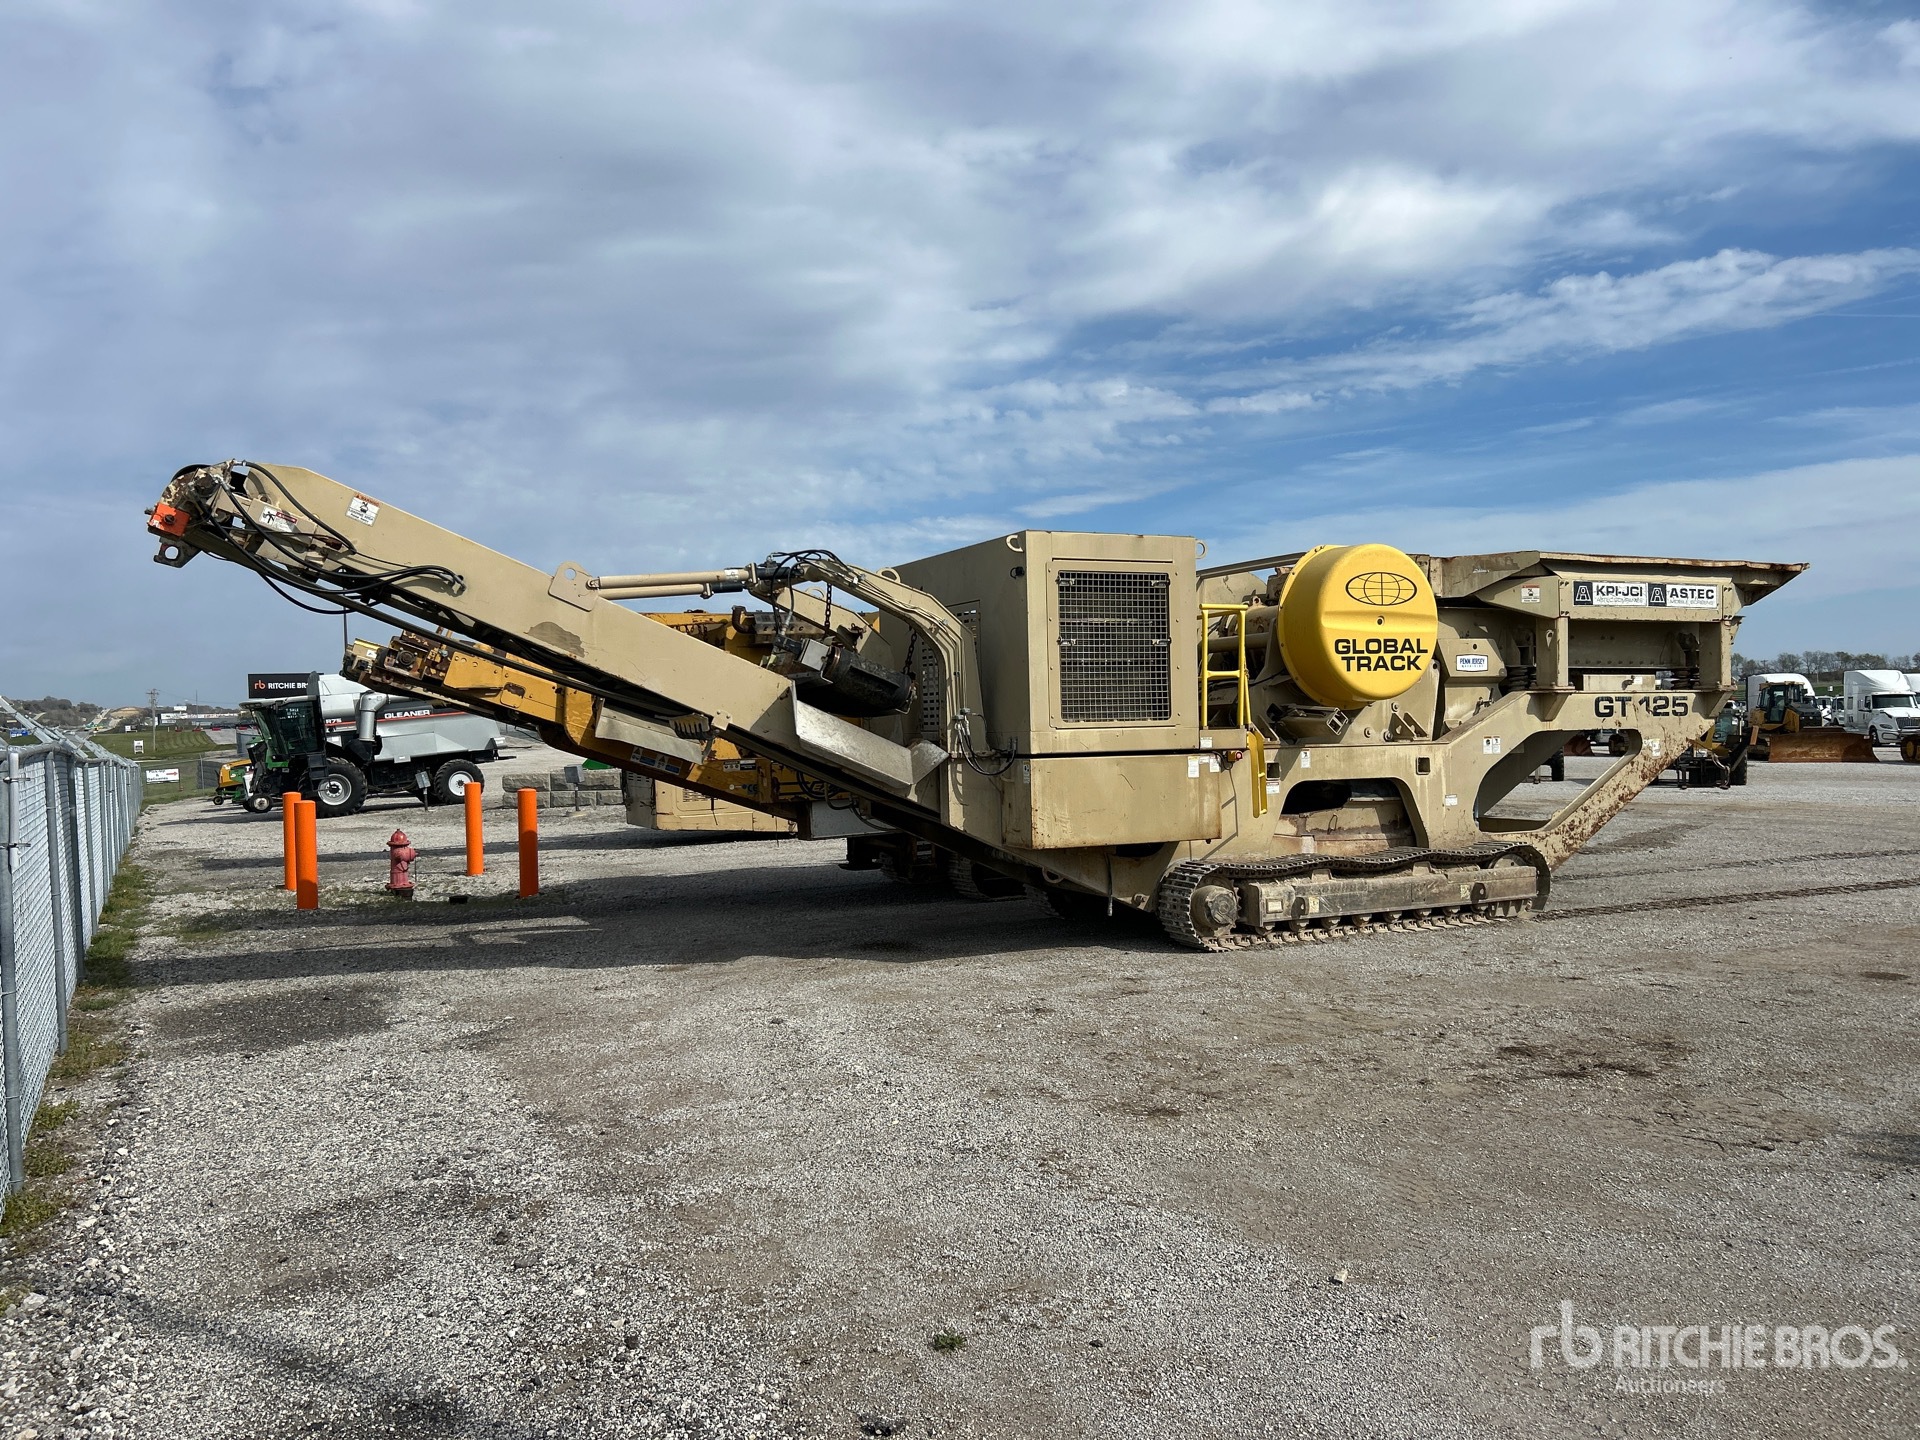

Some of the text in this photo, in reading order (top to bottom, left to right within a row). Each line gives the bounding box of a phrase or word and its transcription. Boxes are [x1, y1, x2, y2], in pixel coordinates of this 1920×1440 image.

[1596, 585, 1643, 597] KPI-JCI
[1669, 587, 1715, 600] ASTEC
[1334, 638, 1429, 655] GLOBAL
[1341, 655, 1422, 672] TRACK
[254, 680, 266, 690] rb
[268, 682, 296, 690] RITCHIE
[1594, 695, 1689, 718] GT 125
[384, 709, 431, 719] GLEANER
